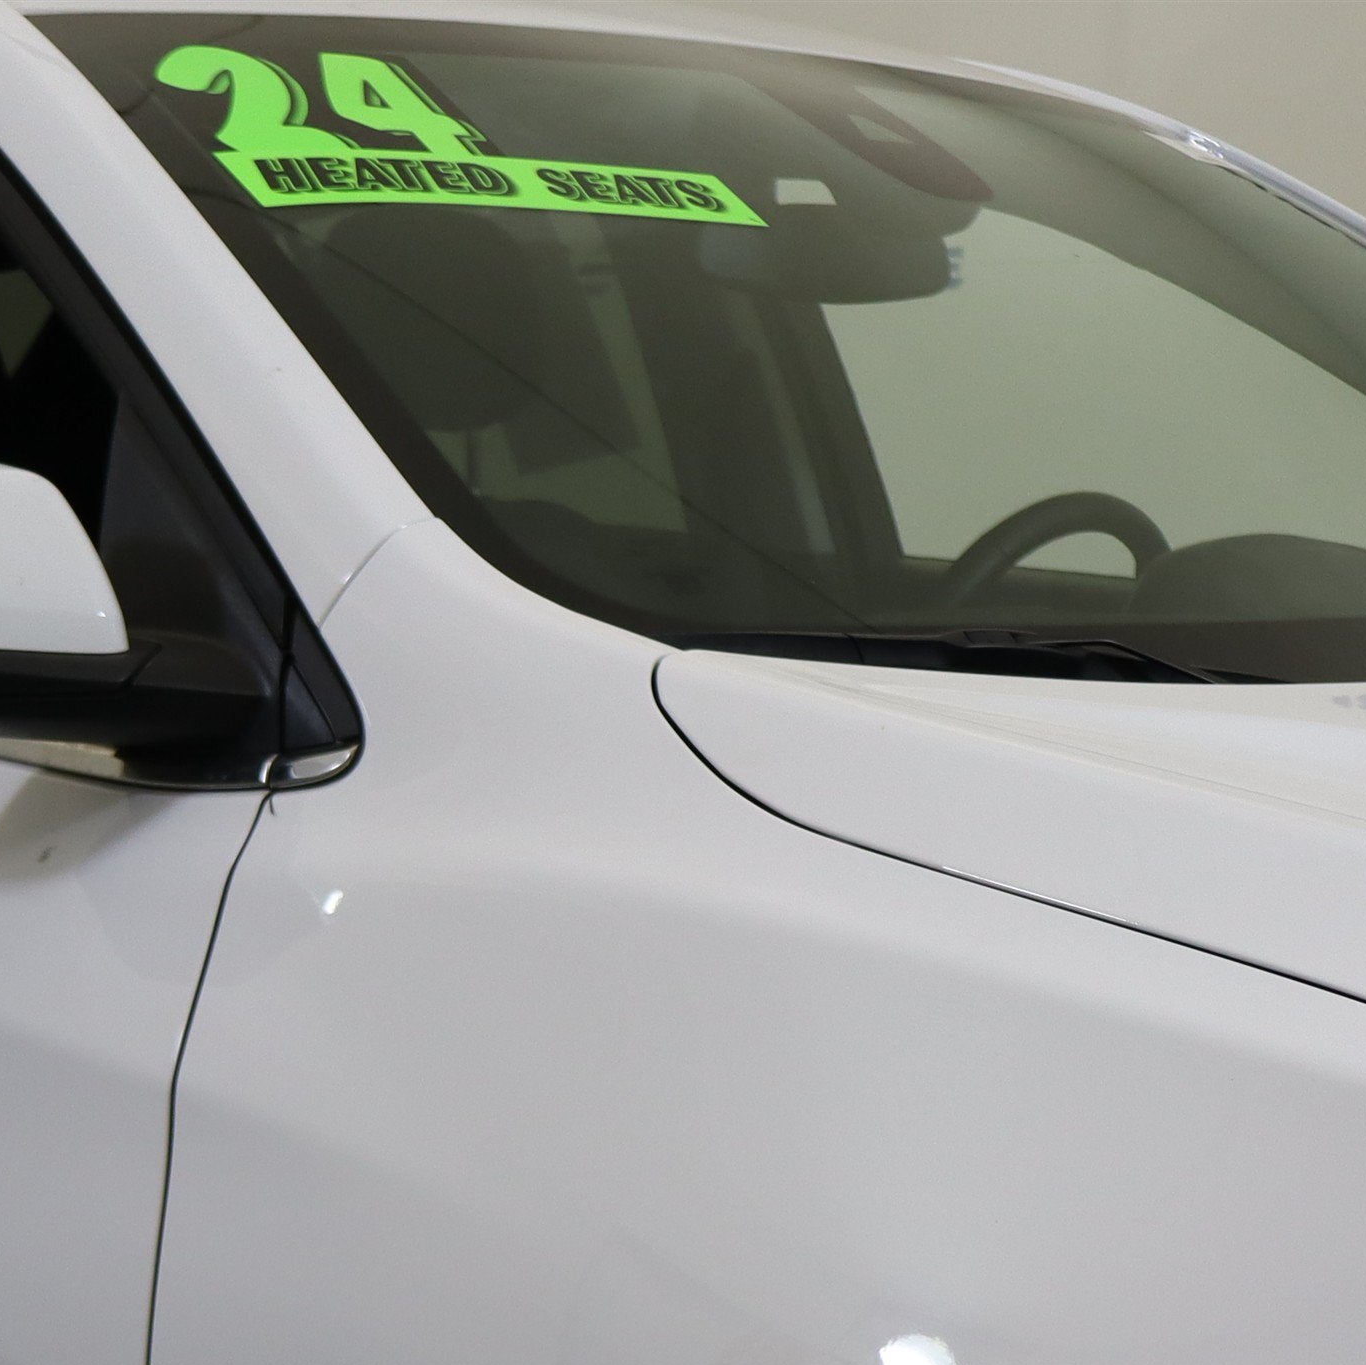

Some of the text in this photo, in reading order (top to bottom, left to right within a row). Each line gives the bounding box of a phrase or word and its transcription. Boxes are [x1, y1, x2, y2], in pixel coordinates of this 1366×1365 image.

[154, 45, 487, 158] 24
[252, 157, 729, 213] HEATED SEATS
